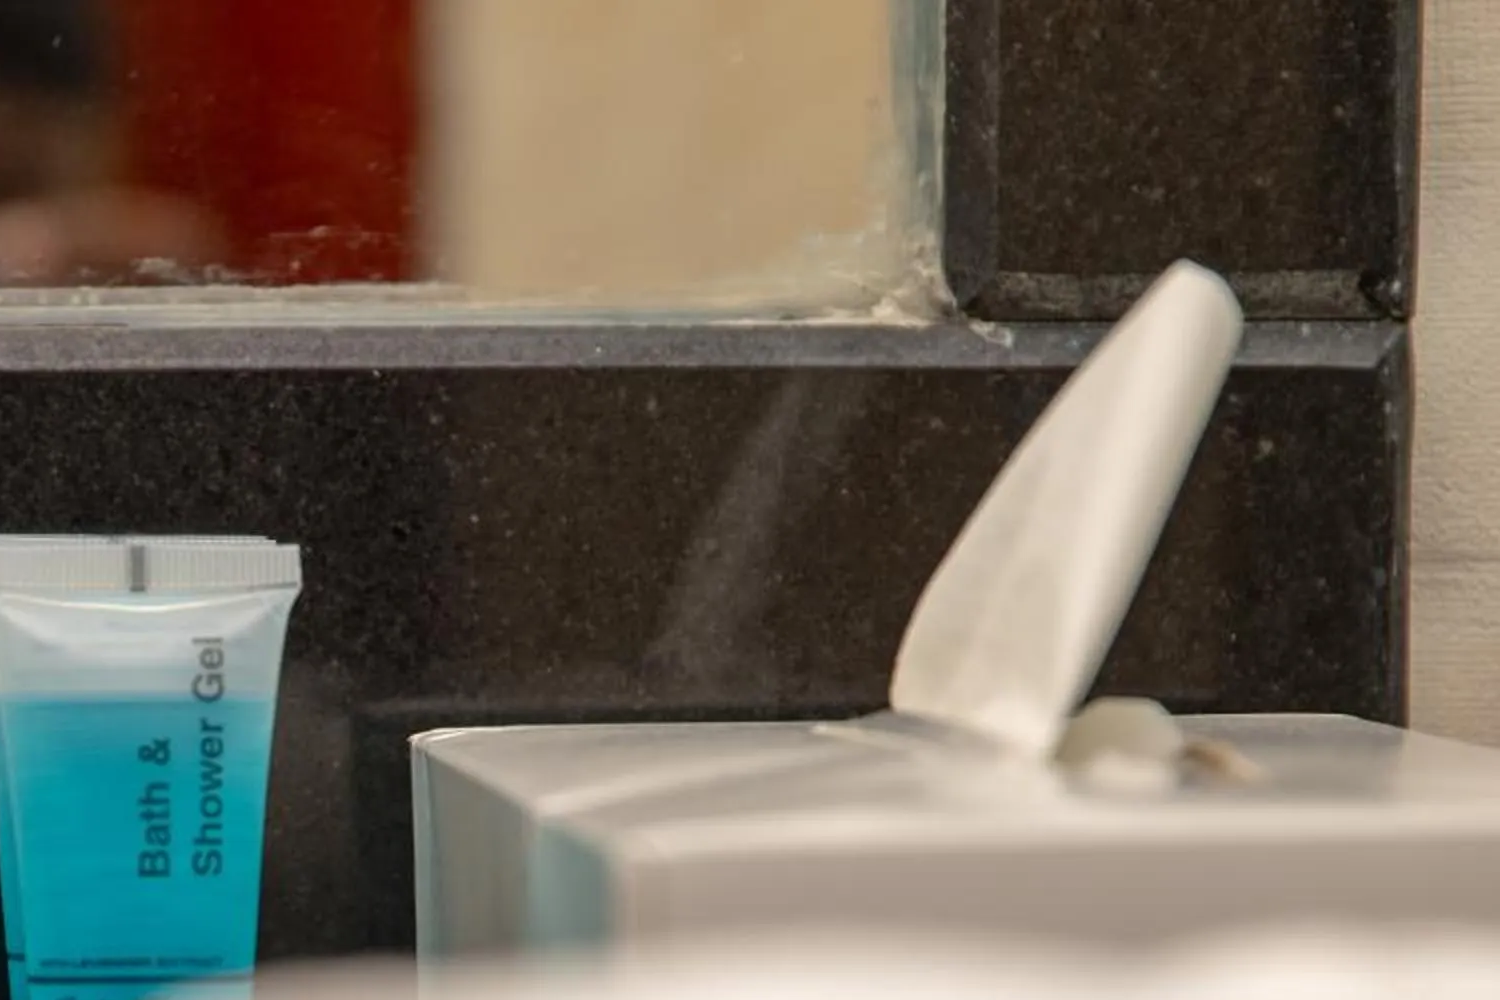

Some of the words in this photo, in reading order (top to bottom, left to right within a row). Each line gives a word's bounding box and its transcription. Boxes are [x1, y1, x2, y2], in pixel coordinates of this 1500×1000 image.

[191, 636, 225, 704] Gel
[137, 737, 171, 766] &
[137, 781, 171, 878] Bath
[191, 719, 225, 876] Shower
